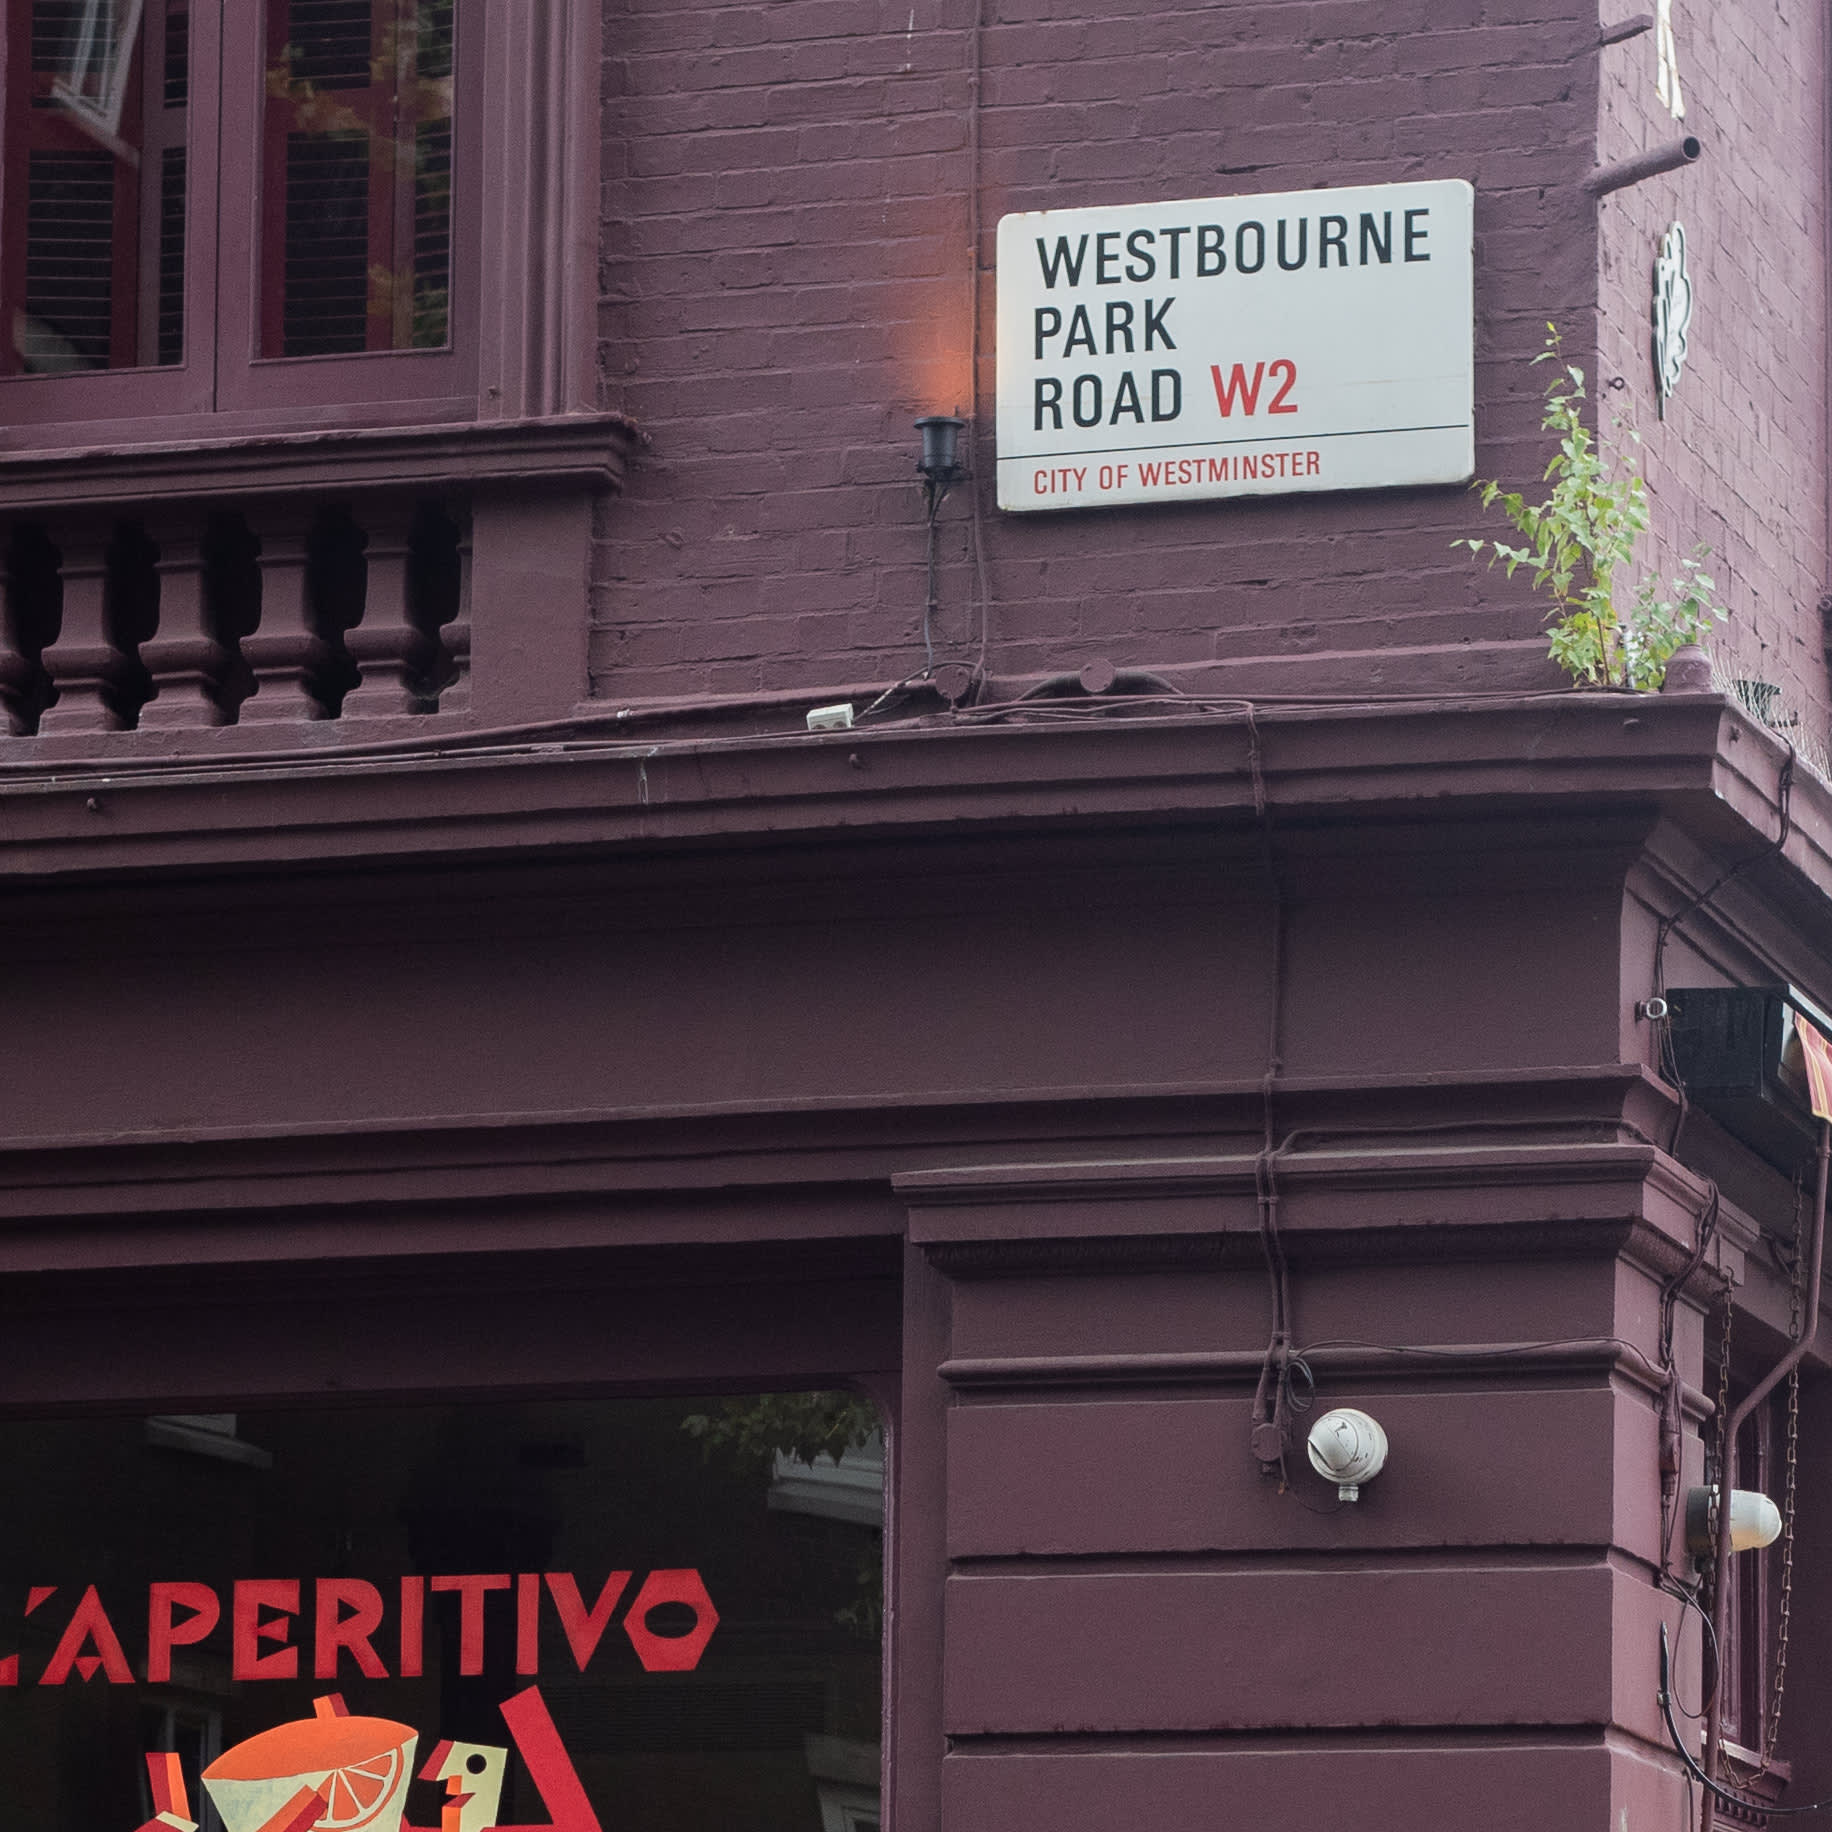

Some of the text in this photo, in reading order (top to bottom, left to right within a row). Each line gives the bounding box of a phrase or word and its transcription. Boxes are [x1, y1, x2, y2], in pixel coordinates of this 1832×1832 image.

[1036, 208, 1431, 289] WESTBOURNE
[1034, 296, 1178, 361] PARK
[1034, 359, 1299, 431] ROAD W2
[1034, 451, 1321, 495] CITY OF WESTMINSTER
